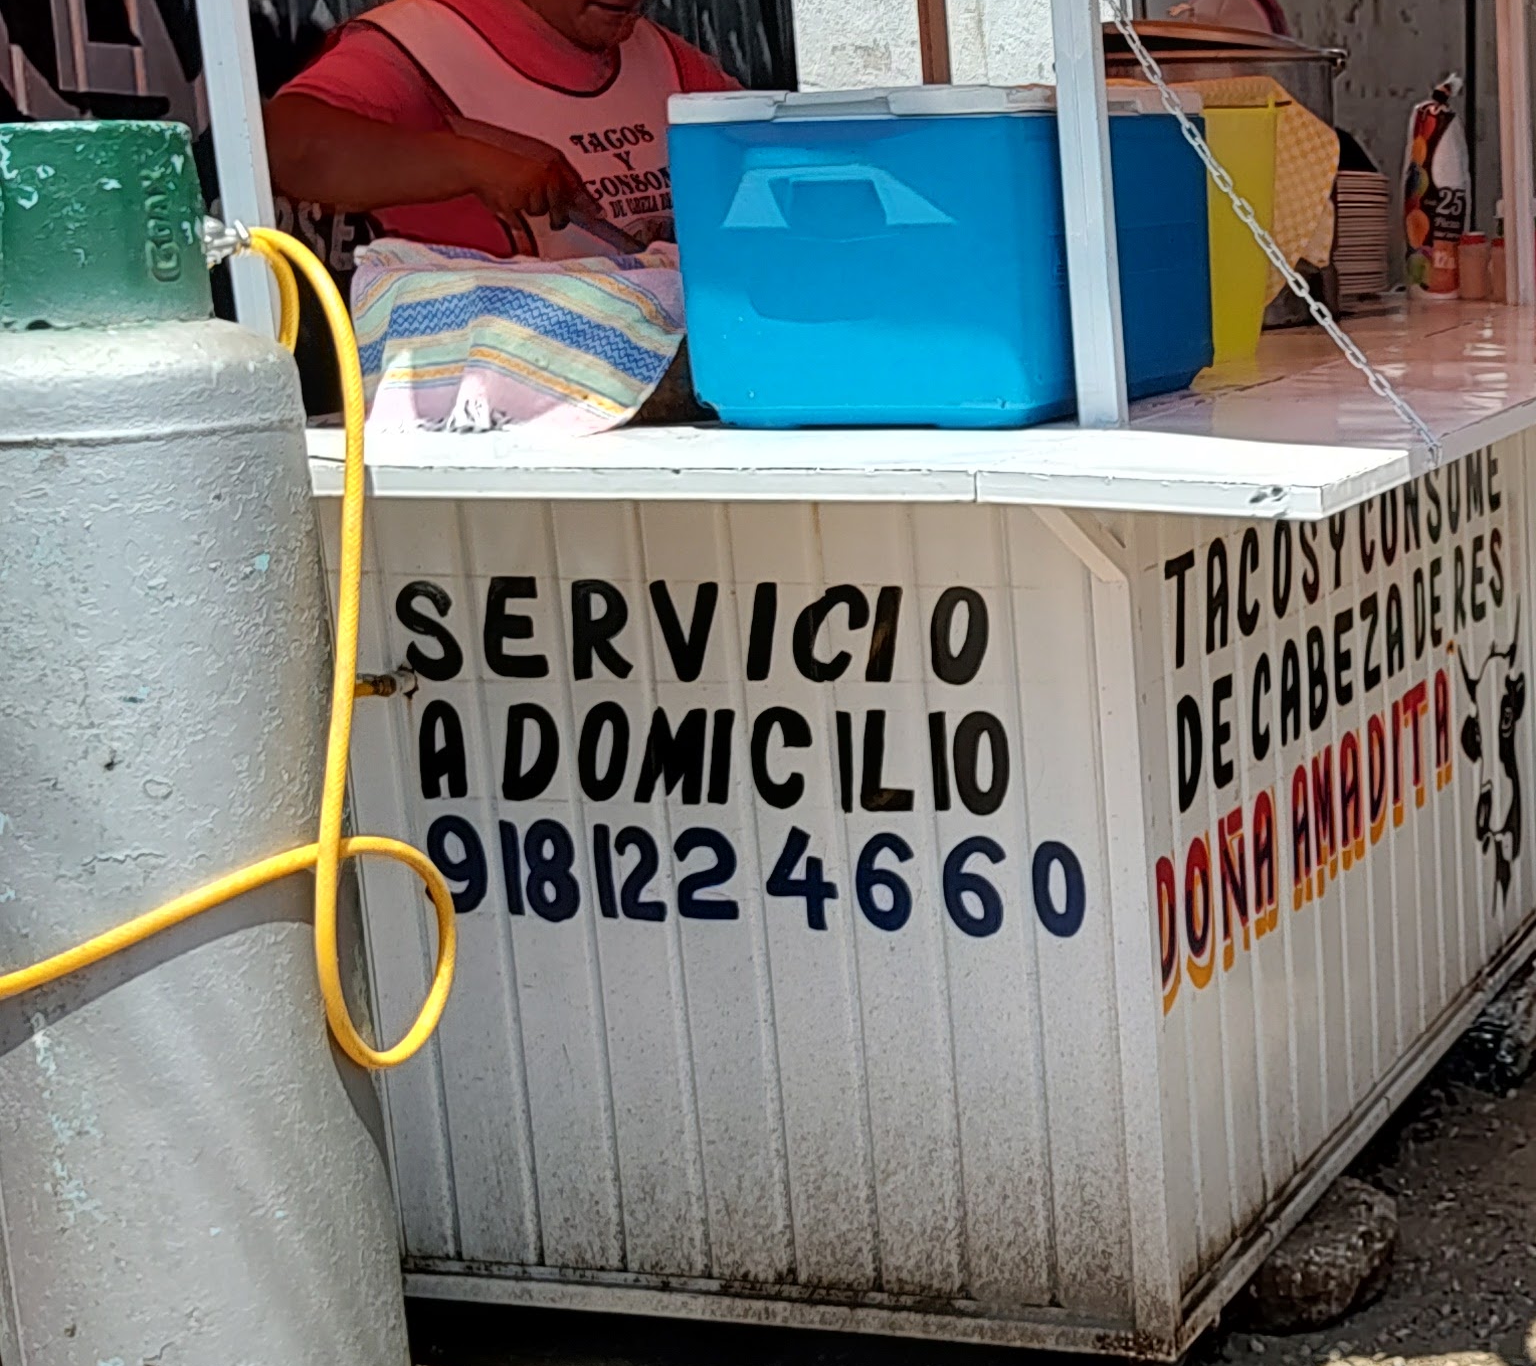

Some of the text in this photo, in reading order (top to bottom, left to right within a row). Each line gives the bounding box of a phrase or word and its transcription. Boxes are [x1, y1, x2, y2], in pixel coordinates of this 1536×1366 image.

[569, 123, 655, 154] TACOS
[612, 150, 636, 172] Y
[1435, 189, 1466, 216] 25
[395, 575, 989, 686] SERVICIO
[1164, 519, 1320, 669] TACOS
[1327, 508, 1347, 591] Y
[1174, 527, 1505, 814] DE CABEZA DE RES
[1155, 668, 1454, 1010] DOÑA AMADITA
